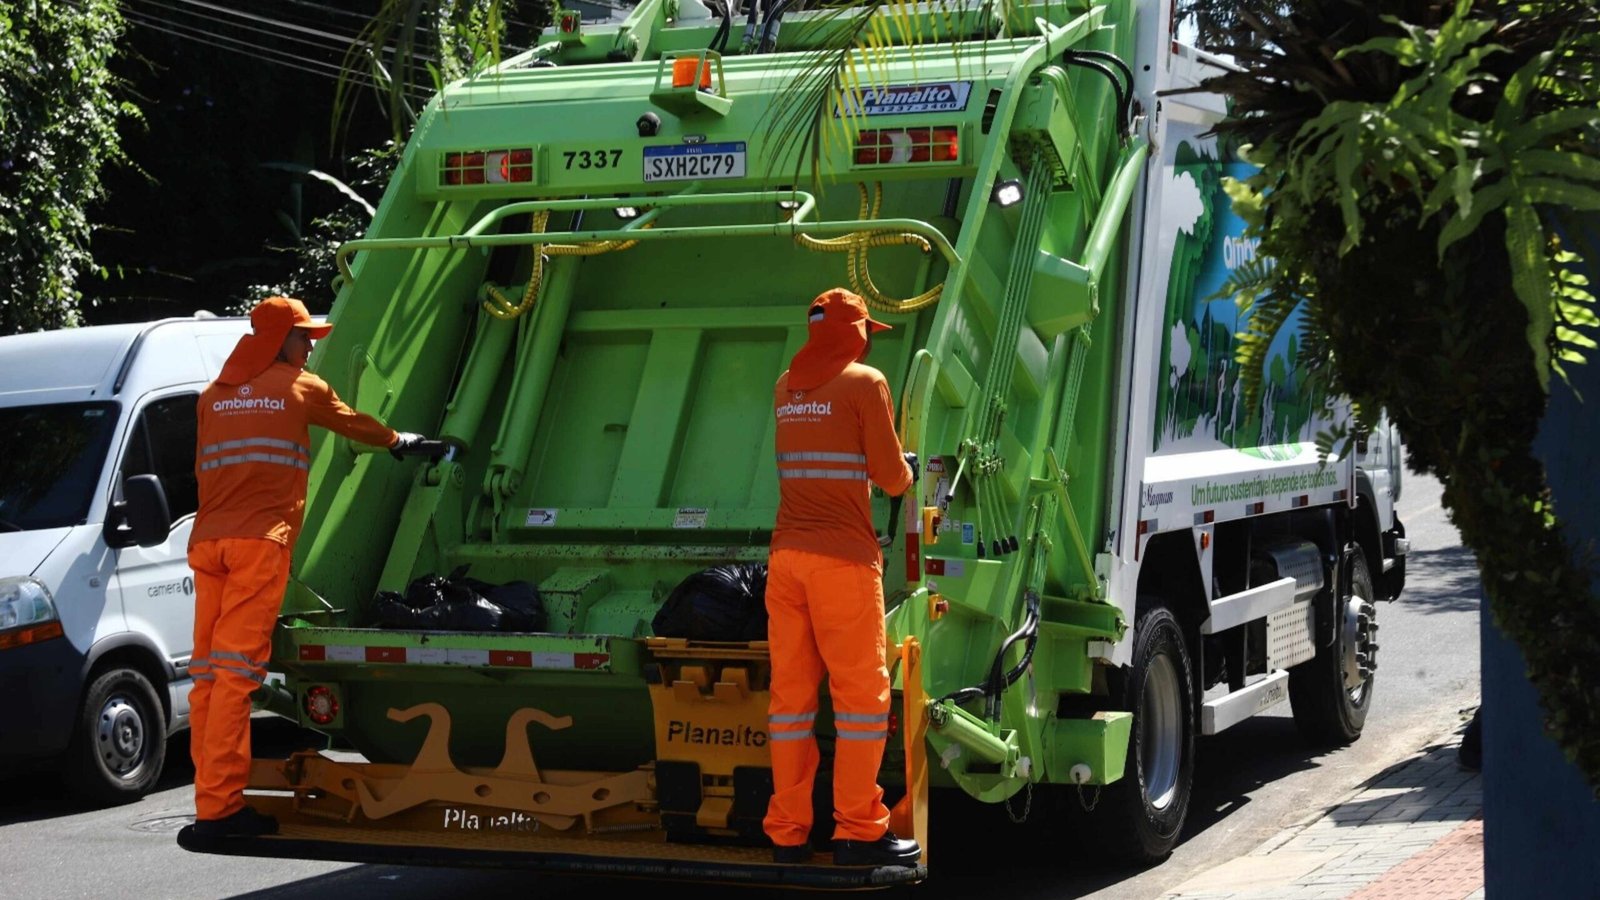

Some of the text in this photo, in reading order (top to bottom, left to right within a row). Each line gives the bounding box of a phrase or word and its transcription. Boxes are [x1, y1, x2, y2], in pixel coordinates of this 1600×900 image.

[863, 86, 951, 105] Planalto
[563, 149, 624, 170] 7337
[652, 154, 735, 178] SXH2C79
[212, 397, 286, 412] ambiental
[777, 400, 832, 418] ambiental
[1191, 481, 1206, 506] Um
[1207, 480, 1230, 504] futuro
[1230, 472, 1271, 501] sustentável
[1272, 471, 1299, 500] depende
[1299, 470, 1308, 490] de
[1308, 468, 1325, 488] todos
[667, 720, 768, 747] Planalto
